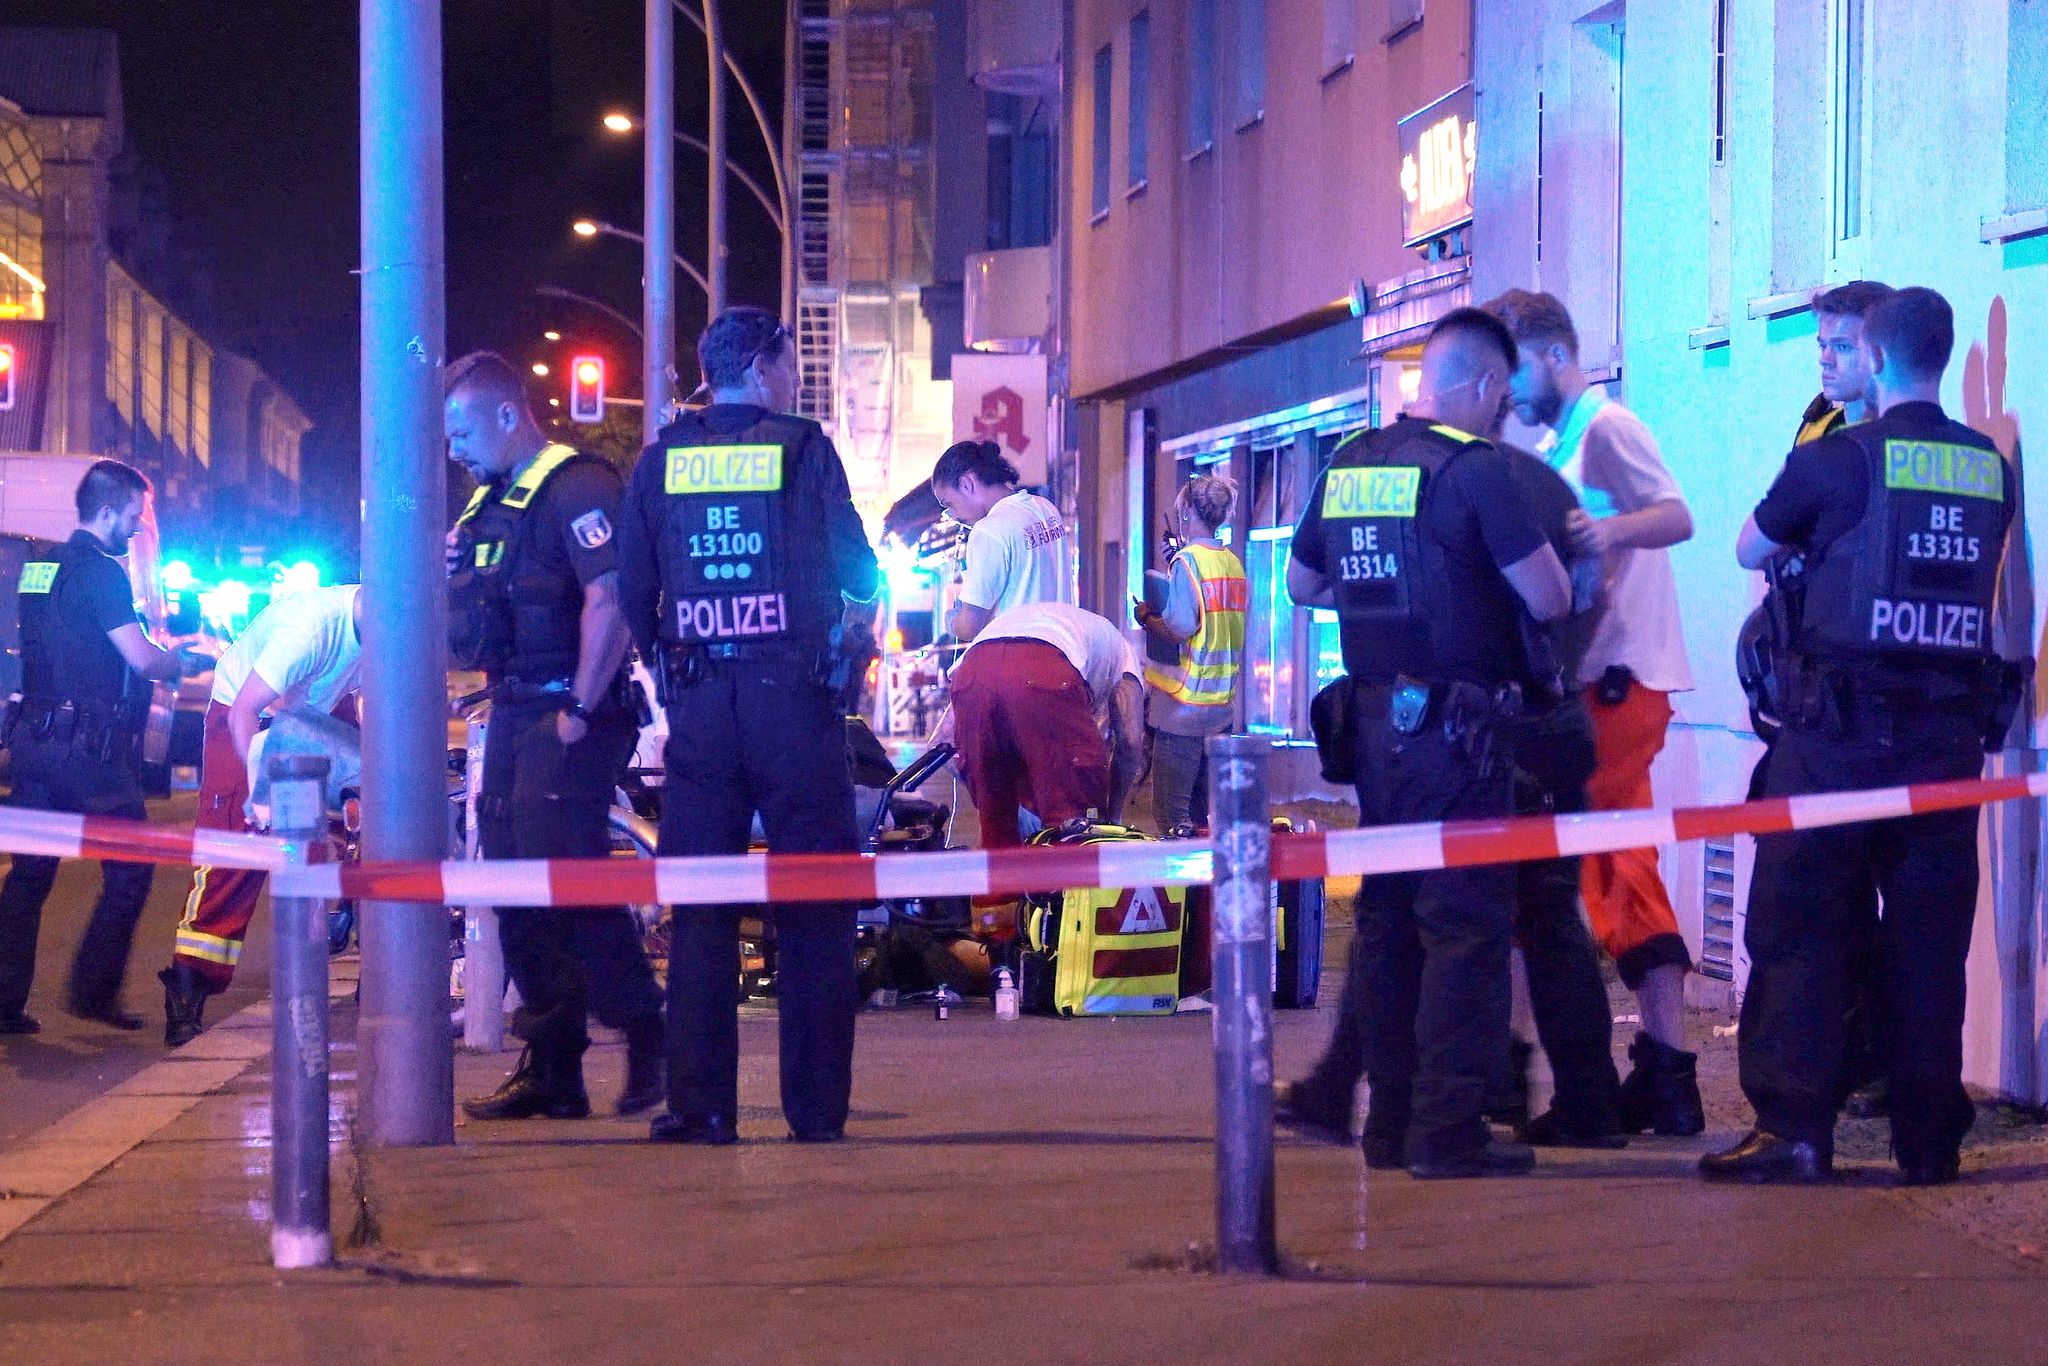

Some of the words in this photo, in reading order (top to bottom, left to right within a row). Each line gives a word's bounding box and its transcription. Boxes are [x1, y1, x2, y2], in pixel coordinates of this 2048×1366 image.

[671, 451, 777, 488] POLIZEI
[1890, 443, 2001, 497] POLIZEI
[1326, 470, 1417, 513] POLIZEI
[706, 506, 740, 530] BE
[1930, 504, 1963, 532] BE
[689, 532, 763, 557] 13100
[1351, 525, 1379, 551] BE
[1908, 532, 1980, 562] 13315
[1340, 553, 1398, 580] 13314
[676, 593, 786, 639] POLIZEI
[1871, 599, 1984, 649] POLIZEI
